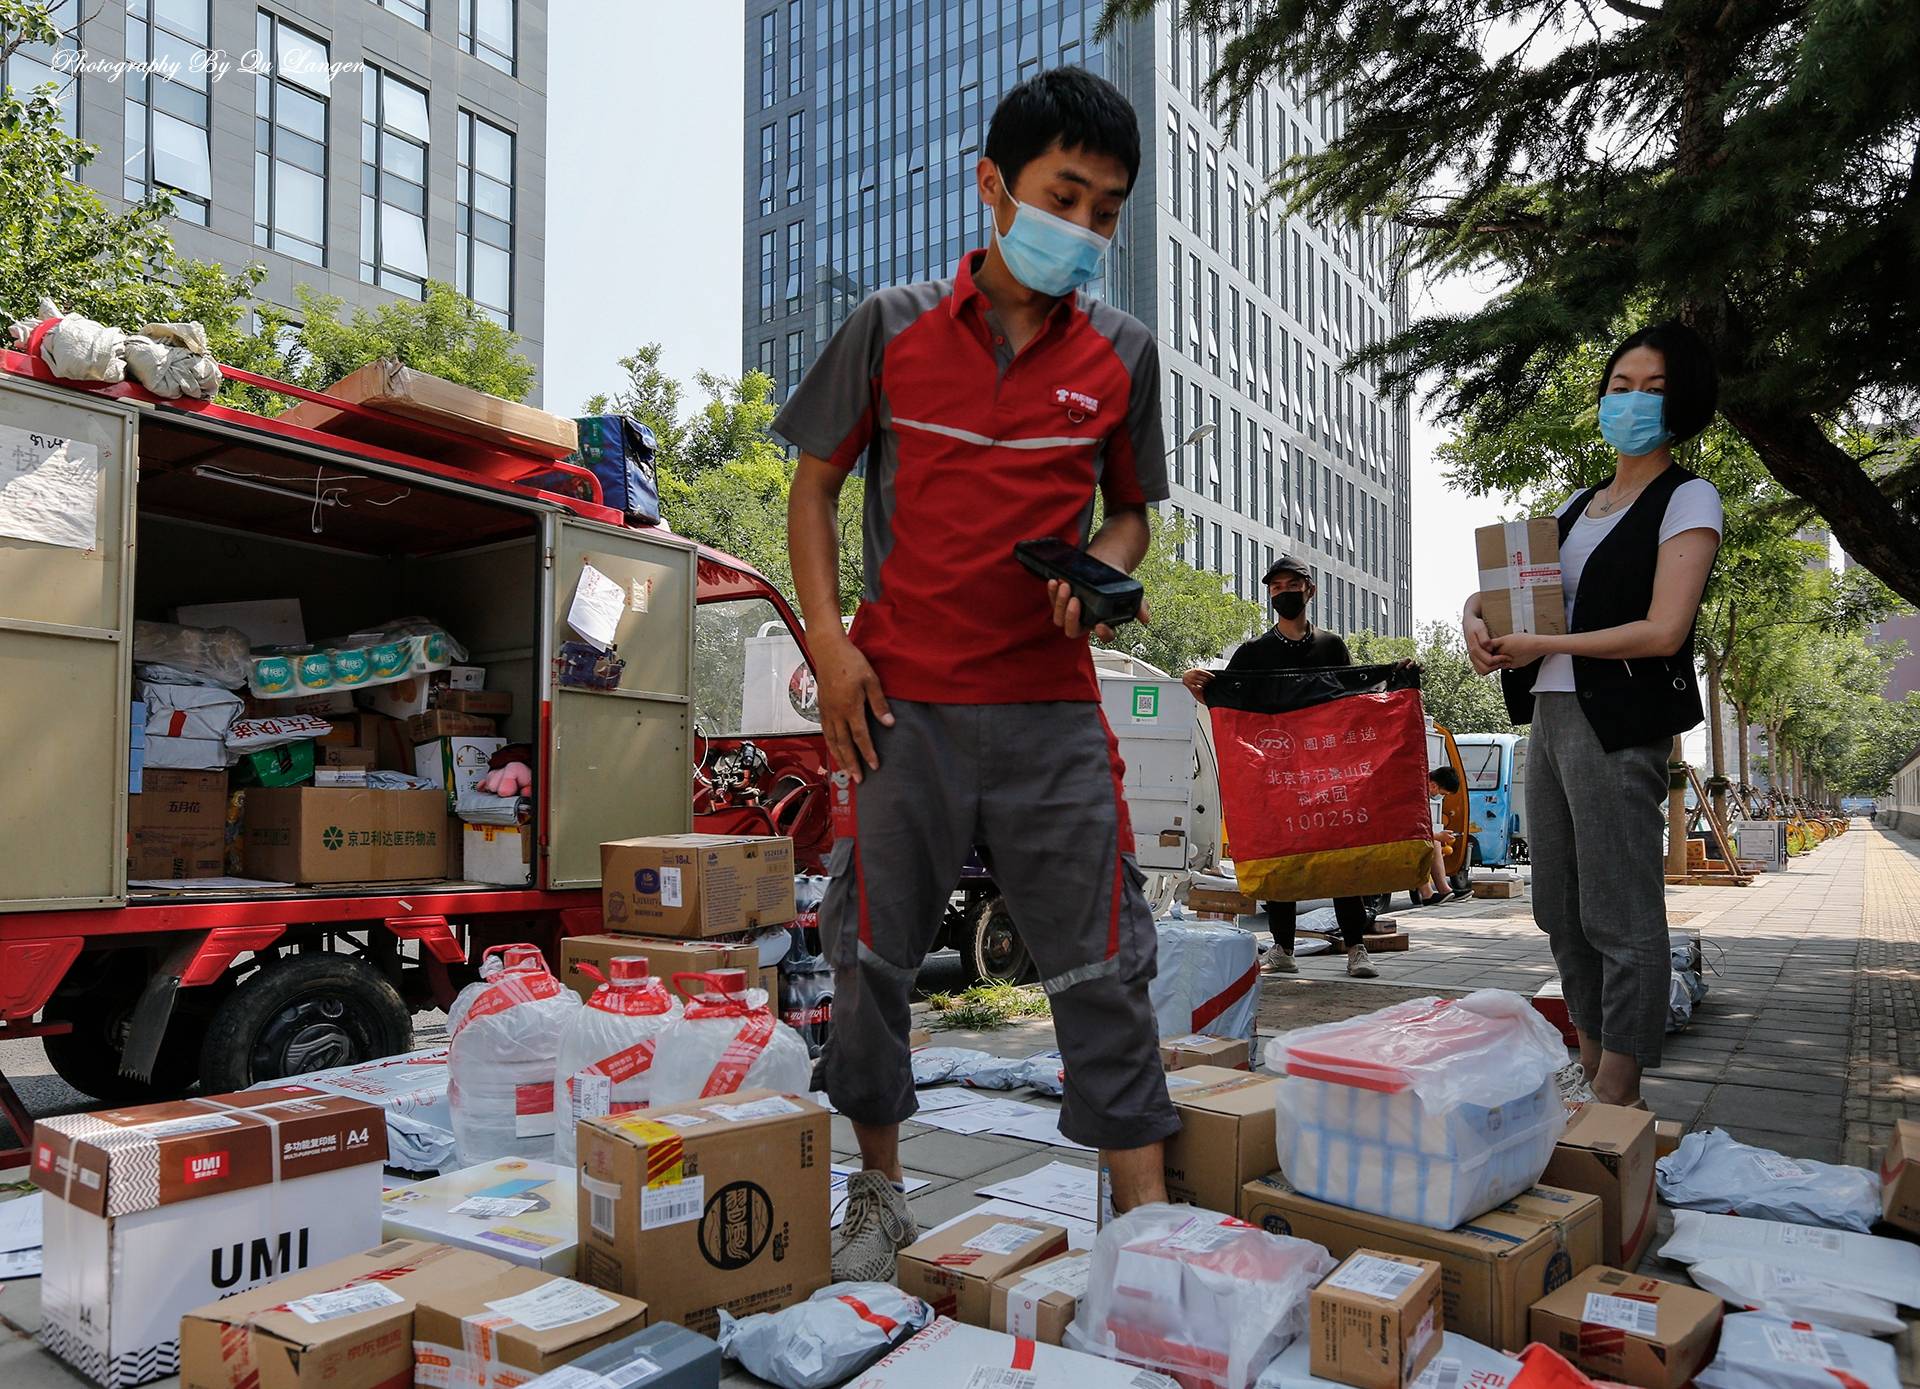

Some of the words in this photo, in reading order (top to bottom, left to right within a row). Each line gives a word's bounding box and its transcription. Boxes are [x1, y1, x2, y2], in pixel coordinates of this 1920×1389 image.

[1297, 785, 1348, 806] 科技园
[347, 830, 437, 847] 京卫利达医药物流
[283, 1134, 337, 1154] 多功能复印纸
[346, 1127, 369, 1145] A4
[191, 1155, 221, 1173] UMI
[210, 1227, 310, 1289] UMI
